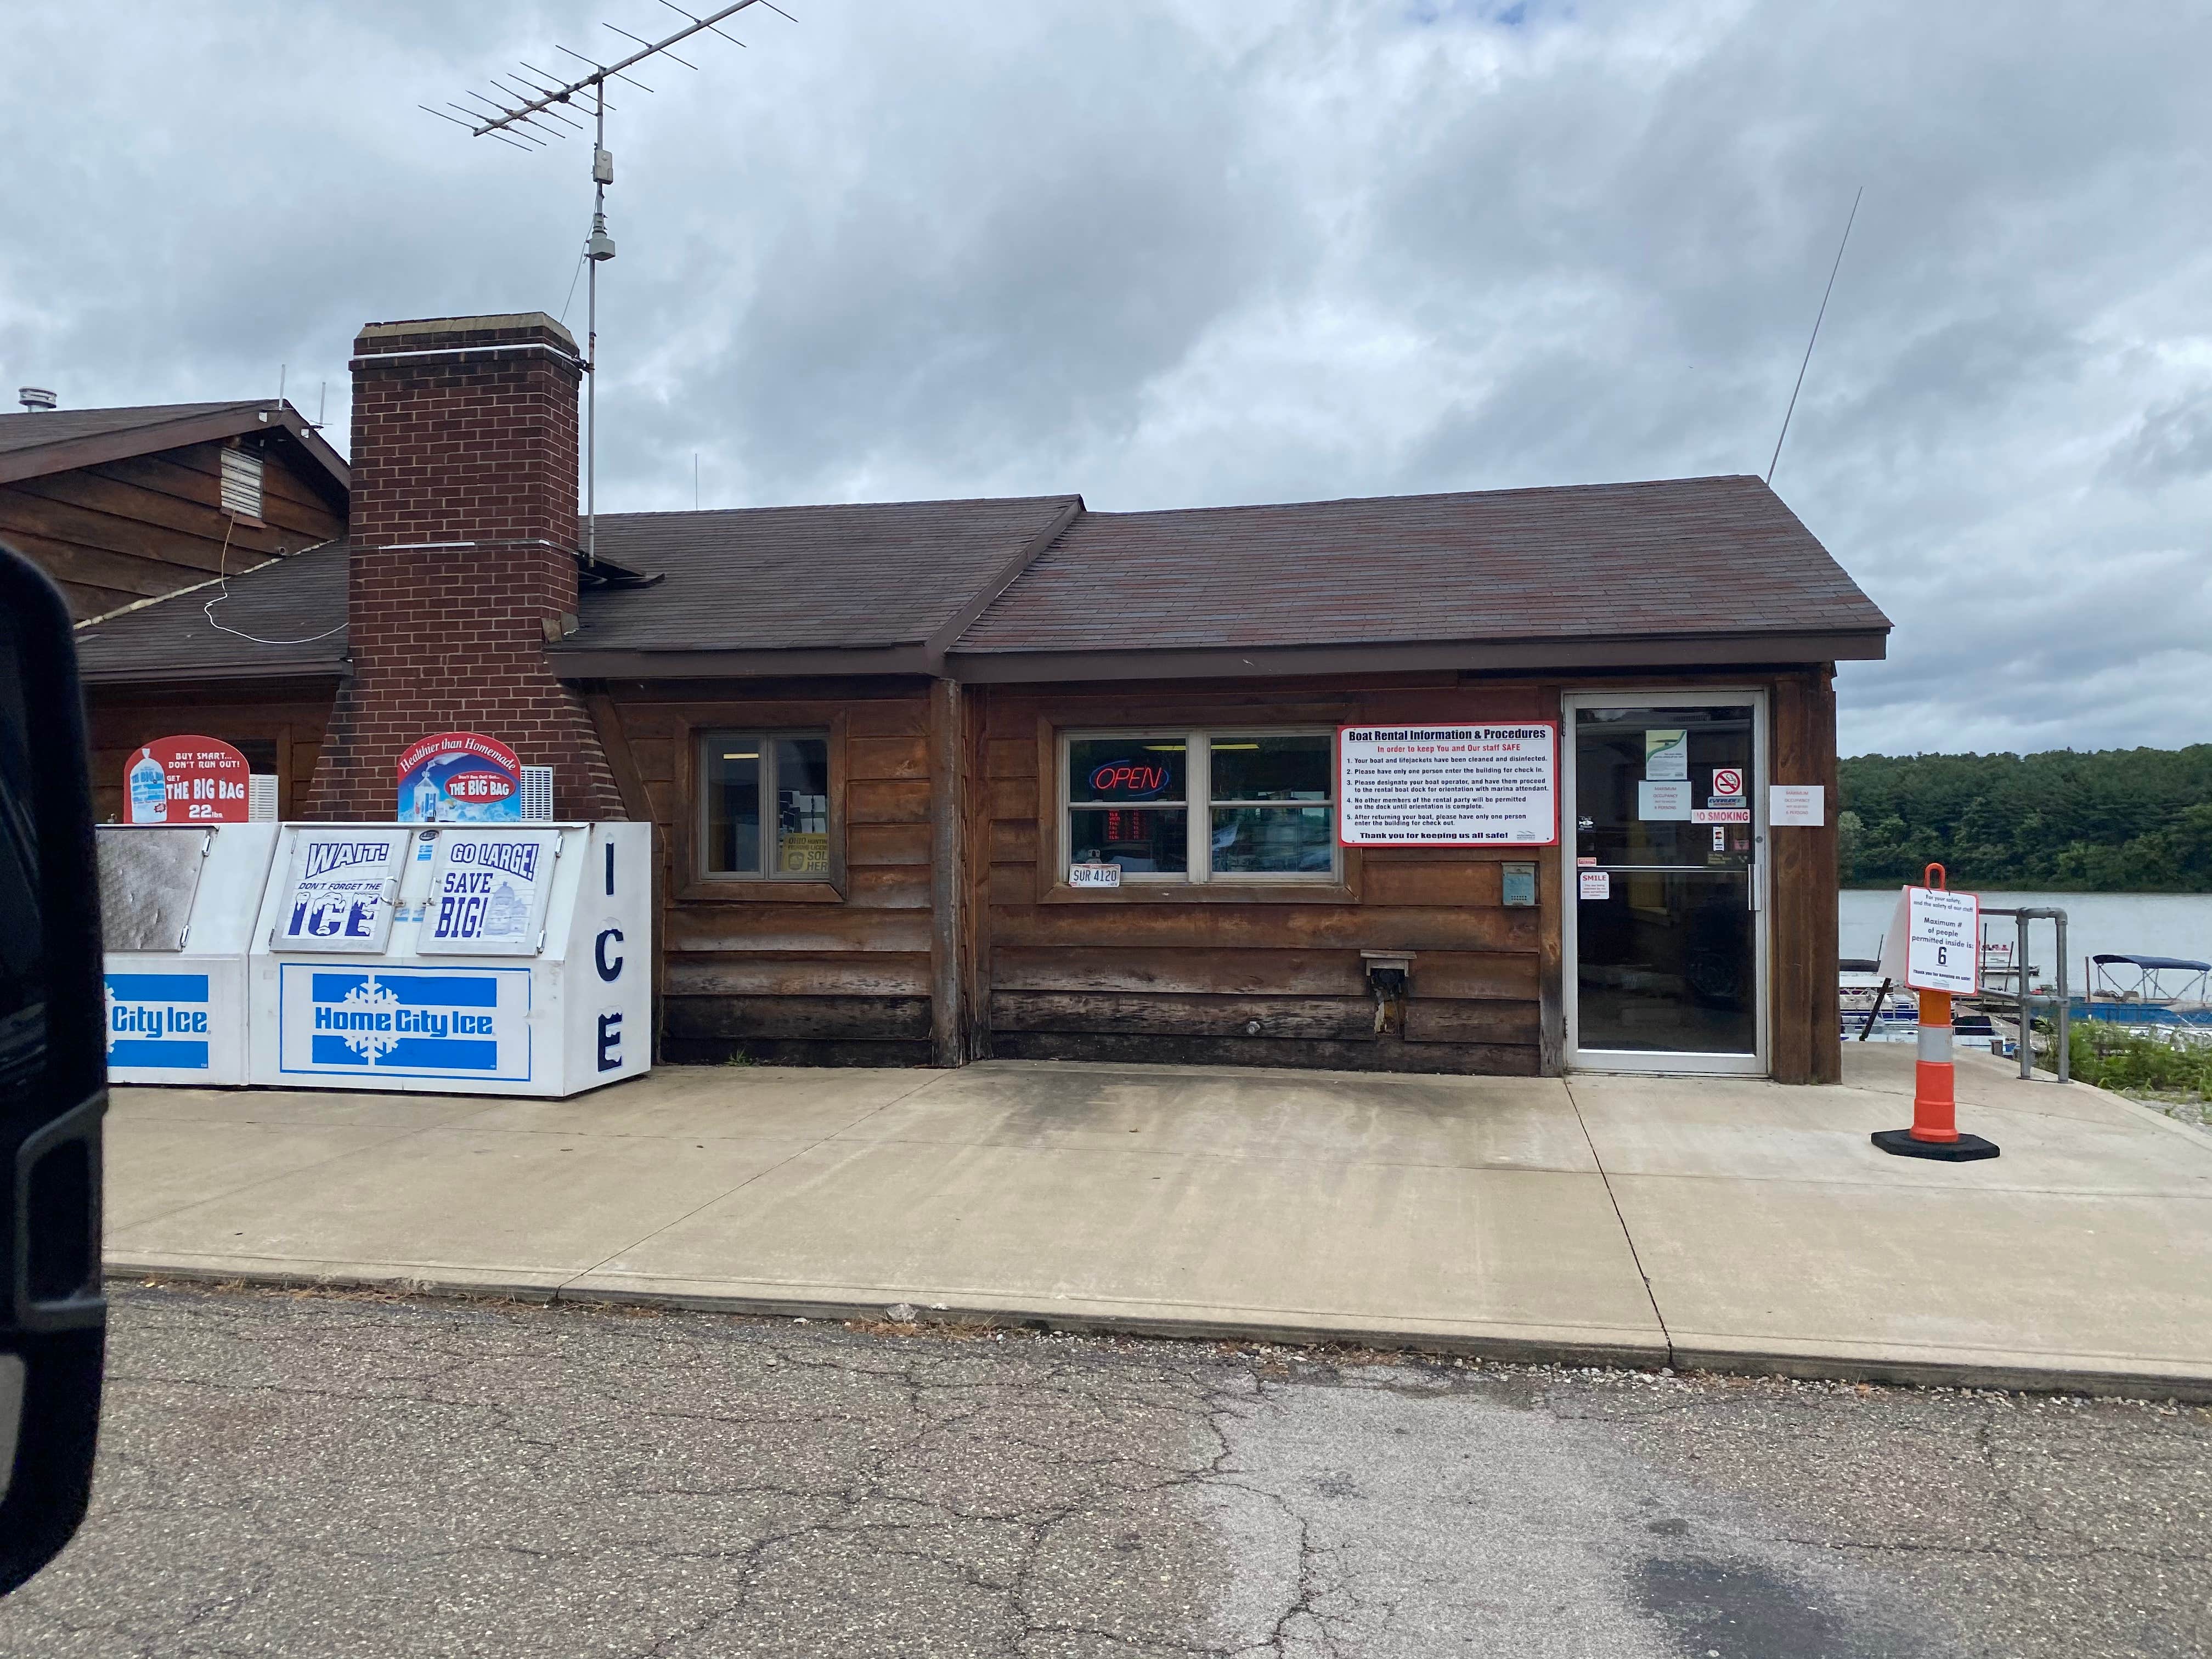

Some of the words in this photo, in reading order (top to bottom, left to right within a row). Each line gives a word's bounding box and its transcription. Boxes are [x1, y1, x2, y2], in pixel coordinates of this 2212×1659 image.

[1350, 731, 1372, 741] Boat
[1375, 731, 1408, 740] Rental
[1410, 730, 1472, 740] Information
[1475, 731, 1481, 739] &
[1485, 729, 1545, 738] Procedures
[399, 743, 440, 773] Healthier
[441, 738, 462, 749] than
[464, 738, 516, 771] Homemade
[166, 781, 189, 800] THE
[193, 778, 215, 800] BIG
[219, 780, 245, 800] BAG
[449, 781, 465, 795] THE
[468, 780, 488, 795] BIG
[490, 781, 510, 795] BAG
[1097, 767, 1162, 789] OPEN
[1708, 812, 1748, 821] SMOKING
[305, 843, 390, 879] WAIT!
[451, 844, 476, 864] GO
[478, 843, 539, 882] LARGE!
[444, 873, 493, 893] SAVE
[1074, 870, 1091, 881] SUR
[1094, 870, 1116, 882] 4120
[287, 892, 380, 936] ICE
[435, 898, 488, 938] BIG!
[1924, 917, 1956, 927] Maximum
[1912, 936, 1943, 944] permitted
[1945, 938, 1965, 947] inside
[596, 834, 624, 1073] ICE
[1938, 947, 1947, 965] 6
[112, 1006, 162, 1038] City
[168, 1007, 207, 1032] Ice
[315, 1007, 391, 1031] Home
[396, 1009, 448, 1037] City
[453, 1012, 493, 1034] Ice
